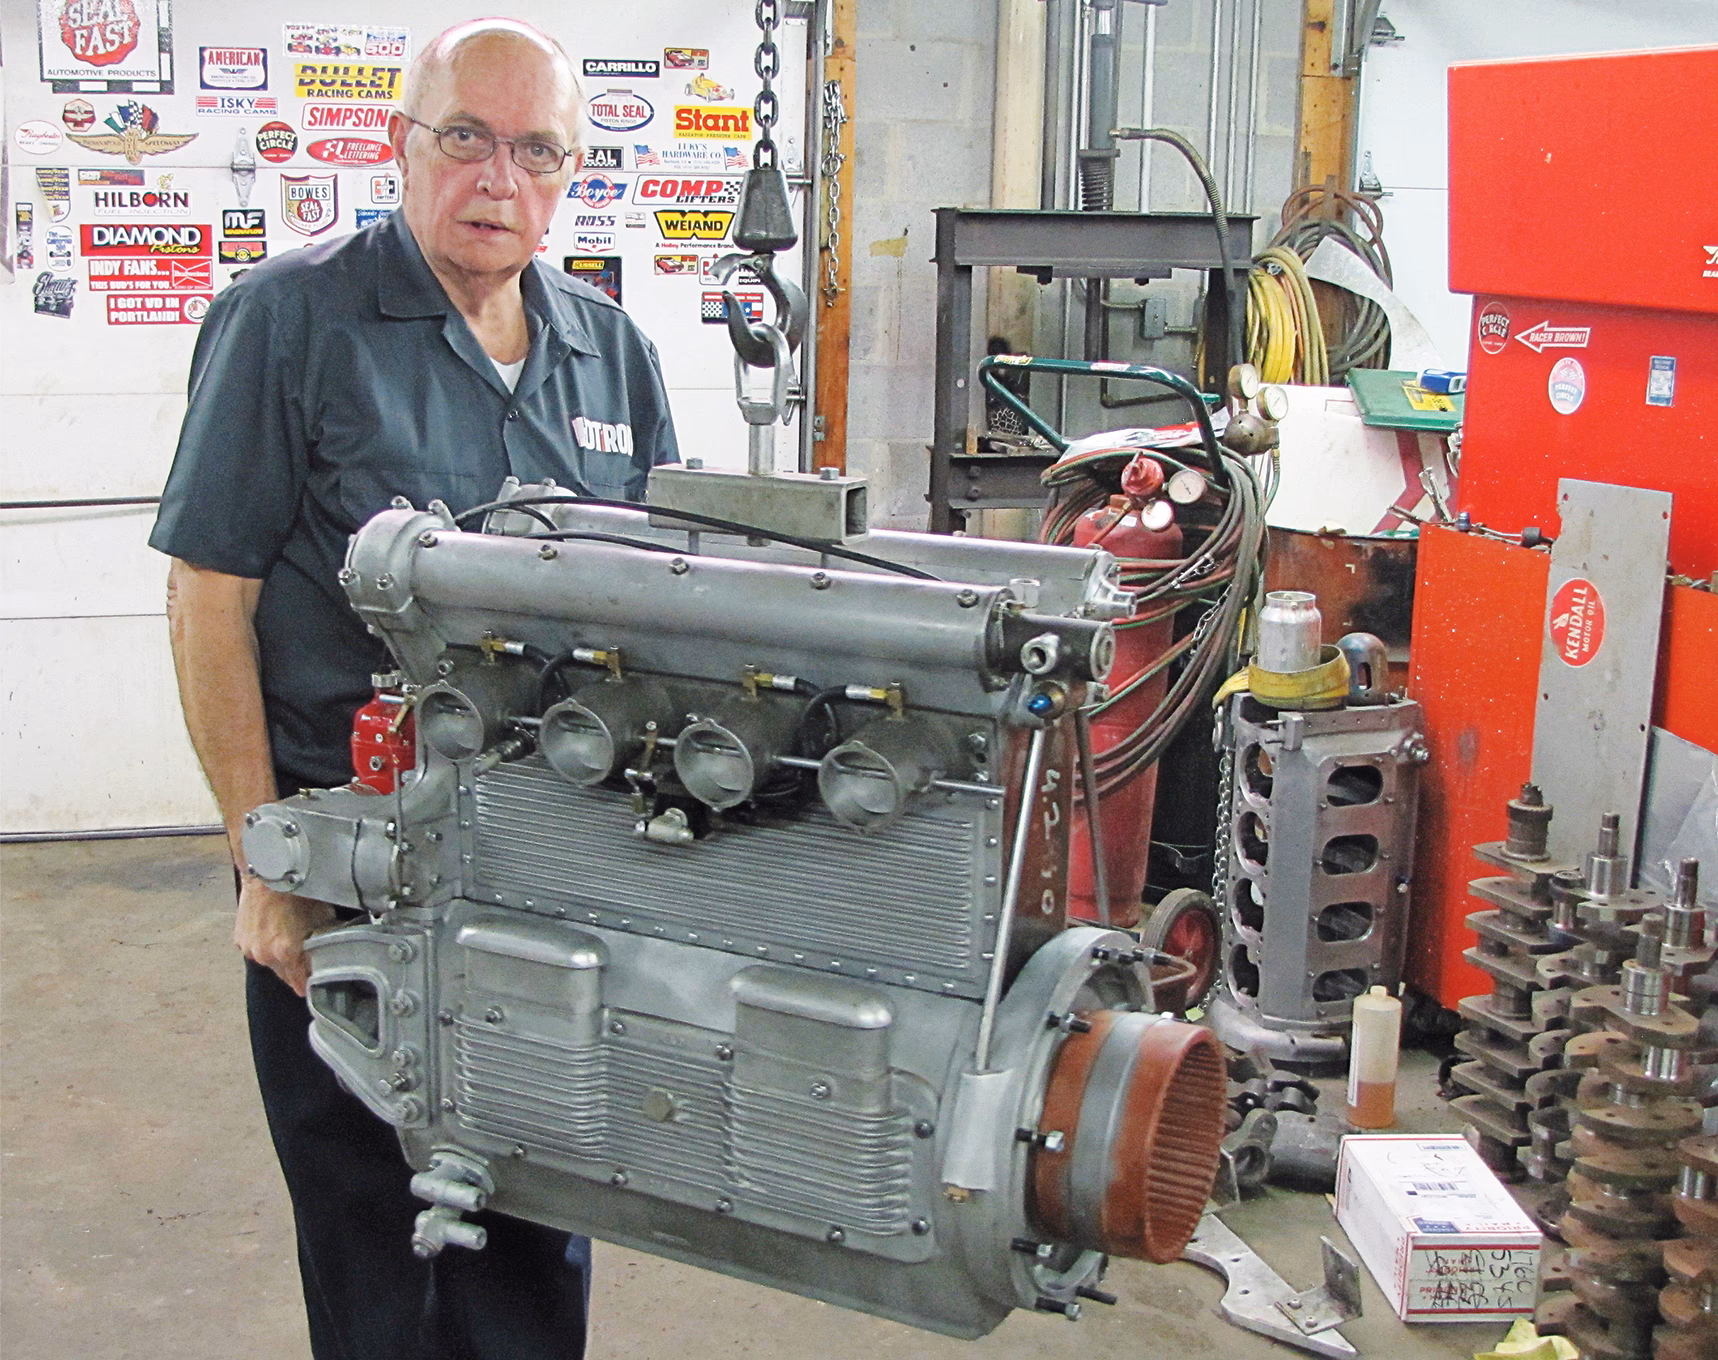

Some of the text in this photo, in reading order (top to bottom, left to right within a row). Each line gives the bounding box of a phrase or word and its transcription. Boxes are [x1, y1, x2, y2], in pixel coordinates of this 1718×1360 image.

[74, 22, 131, 55] FAST
[208, 51, 261, 66] AMERICAN
[47, 68, 157, 78] AUTOMOTIVE PRODUCTS
[586, 62, 657, 73] CARRILLO
[298, 65, 402, 89] BULLET
[307, 89, 393, 100] RACING CAMS
[220, 98, 255, 108] ISKY
[591, 104, 647, 118] TOTAL SEAL
[308, 107, 390, 128] SIMPSON
[675, 108, 749, 132] Stant
[257, 130, 297, 141] PERFECT
[260, 139, 294, 151] CIRCLE
[346, 142, 382, 152] FREELANCE
[344, 151, 379, 160] LETTERING
[662, 151, 708, 159] HARDWARE
[291, 187, 328, 198] BOWES
[571, 184, 628, 202] Boyce
[640, 179, 724, 198] COMP
[95, 191, 189, 208] HILBORN
[301, 201, 319, 211] SEAL
[303, 210, 320, 222] FAST
[574, 215, 617, 226] ROSS
[665, 219, 723, 231] WEIAND
[93, 226, 201, 245] DIAMOND
[577, 236, 611, 244] Mobil
[150, 243, 200, 255] Pistons
[90, 260, 170, 276] INDY FANS...
[90, 281, 108, 289] THIS
[109, 281, 133, 289] BUD'S
[135, 281, 151, 289] FOR
[110, 297, 115, 309] I
[117, 297, 143, 309] GOT
[144, 297, 164, 309] VD
[165, 297, 180, 309] IN
[109, 310, 180, 322] PORTLAND!
[1481, 313, 1510, 326] PERFECT
[1529, 332, 1586, 343] RACER BROWN!
[1553, 382, 1578, 395] PERFECT
[1554, 391, 1576, 401] CIRCLE
[1564, 586, 1588, 660] KENDALL
[1581, 600, 1596, 653] MOTOR OIL
